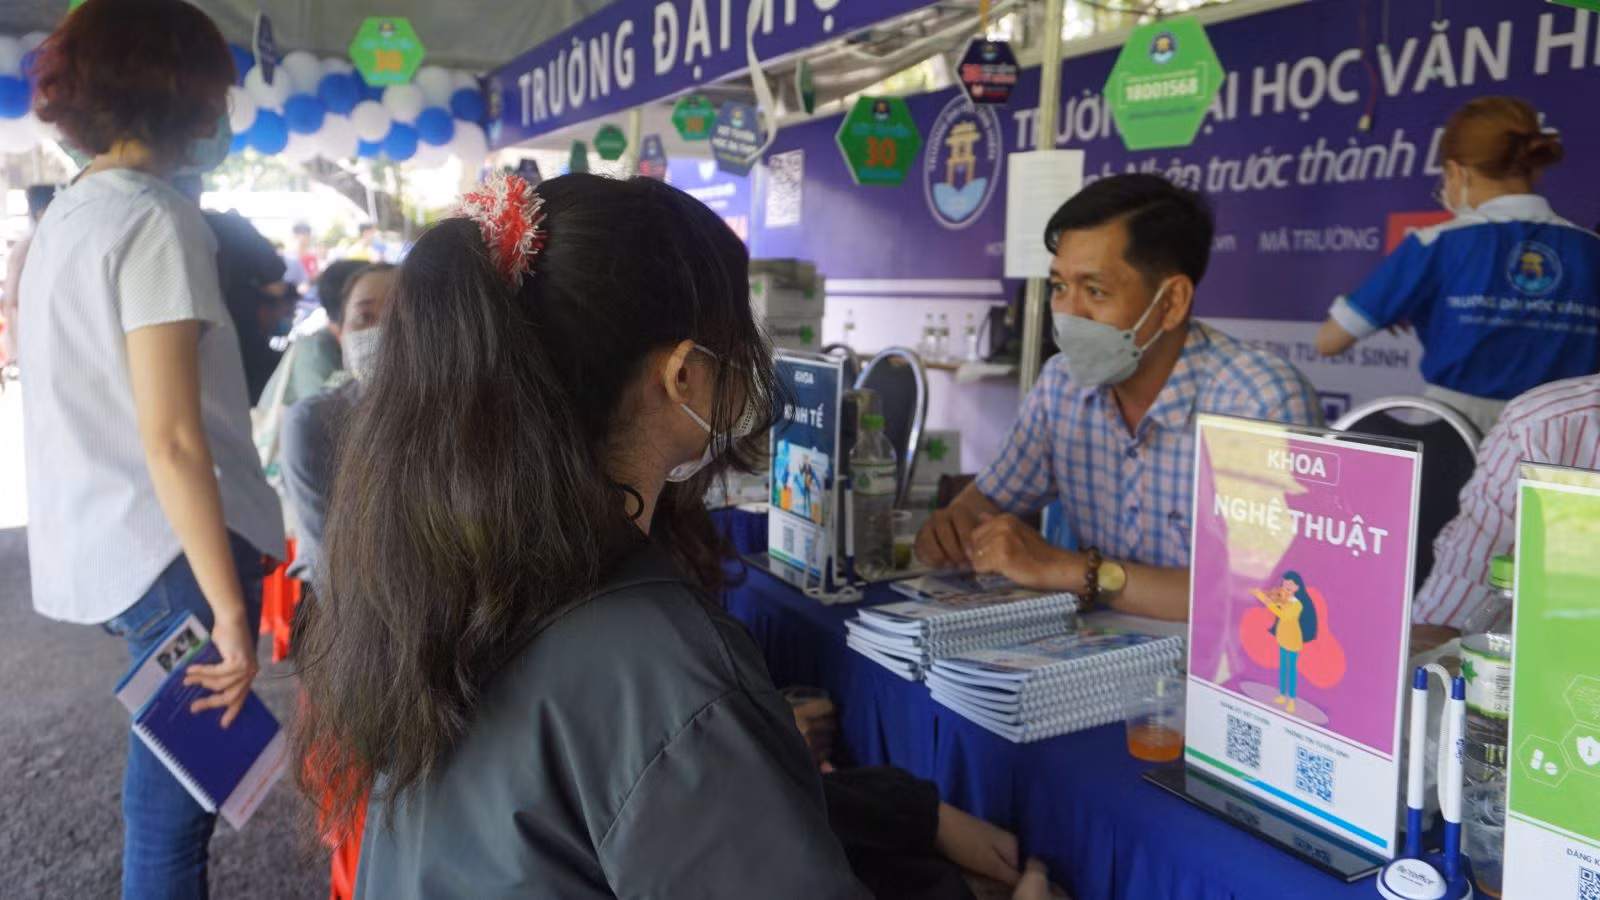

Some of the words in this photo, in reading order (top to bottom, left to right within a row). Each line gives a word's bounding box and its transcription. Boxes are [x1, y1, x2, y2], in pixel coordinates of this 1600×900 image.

[518, 20, 635, 126] TRƯỜNG
[1251, 49, 1362, 121] HỌC
[1377, 19, 1512, 96] VĂN
[865, 134, 896, 168] 30
[1298, 128, 1416, 184] thành
[1361, 347, 1409, 368] SINH
[1266, 448, 1327, 478] KHOA
[1213, 493, 1282, 536] NGHỆ
[1287, 508, 1388, 557] THUẬT
